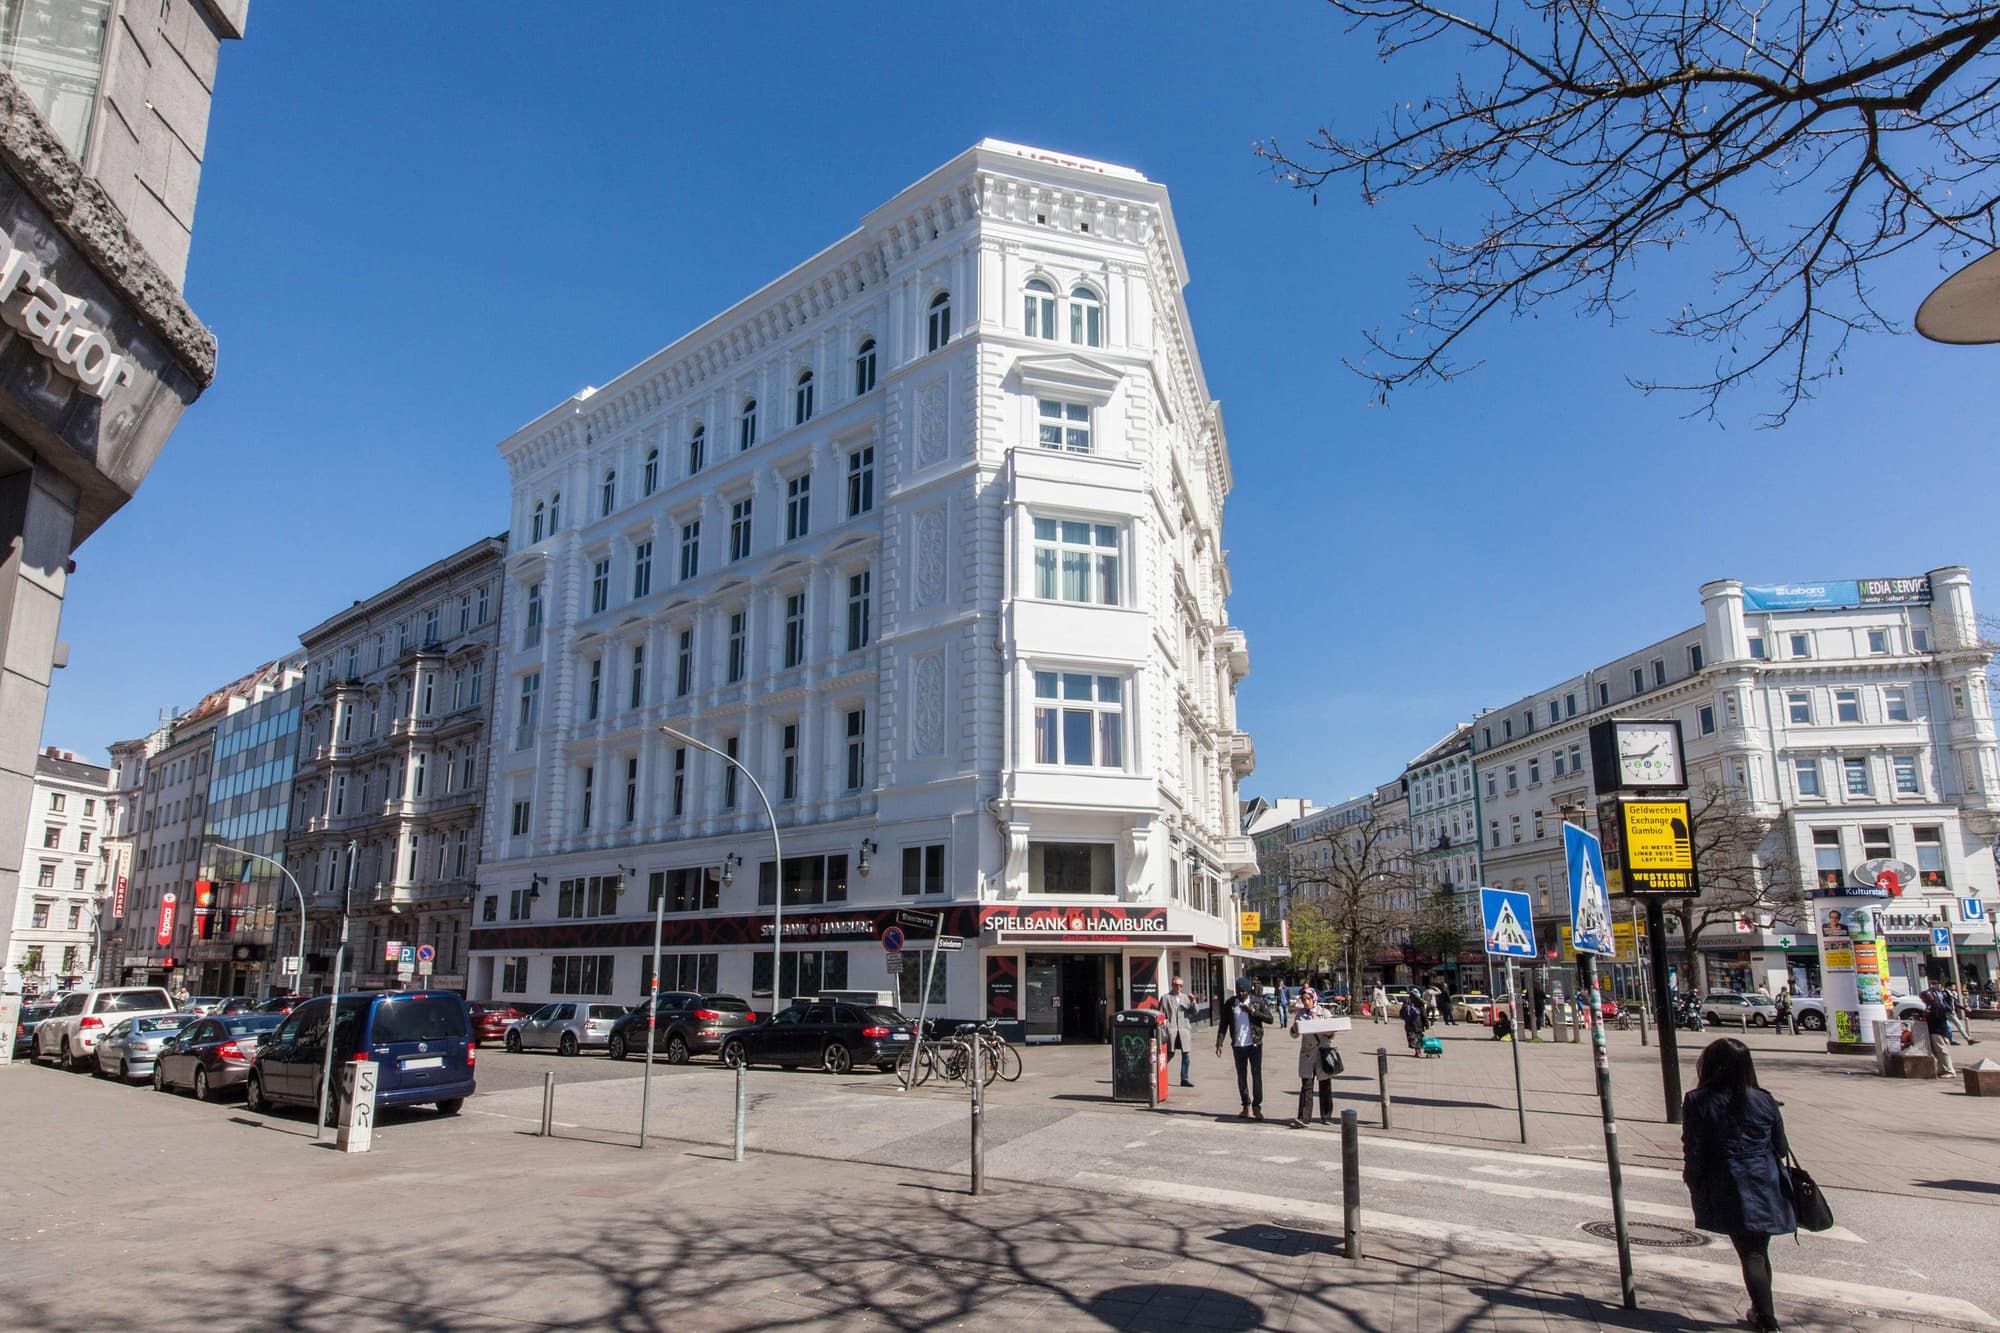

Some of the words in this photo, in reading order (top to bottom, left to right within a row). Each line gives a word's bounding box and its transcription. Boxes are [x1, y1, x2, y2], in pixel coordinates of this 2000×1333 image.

[1630, 806, 1681, 815] Geldwechsel
[1631, 817, 1670, 826] Exchange
[1633, 873, 1685, 881] WESTERN
[1650, 880, 1685, 888] UNION
[1965, 900, 1982, 918] U
[160, 908, 172, 937] tipico
[820, 920, 873, 934] HAMBURG
[985, 916, 1067, 931] SPIELBANK
[1087, 918, 1164, 931] HAMBURG
[401, 948, 411, 961] P
